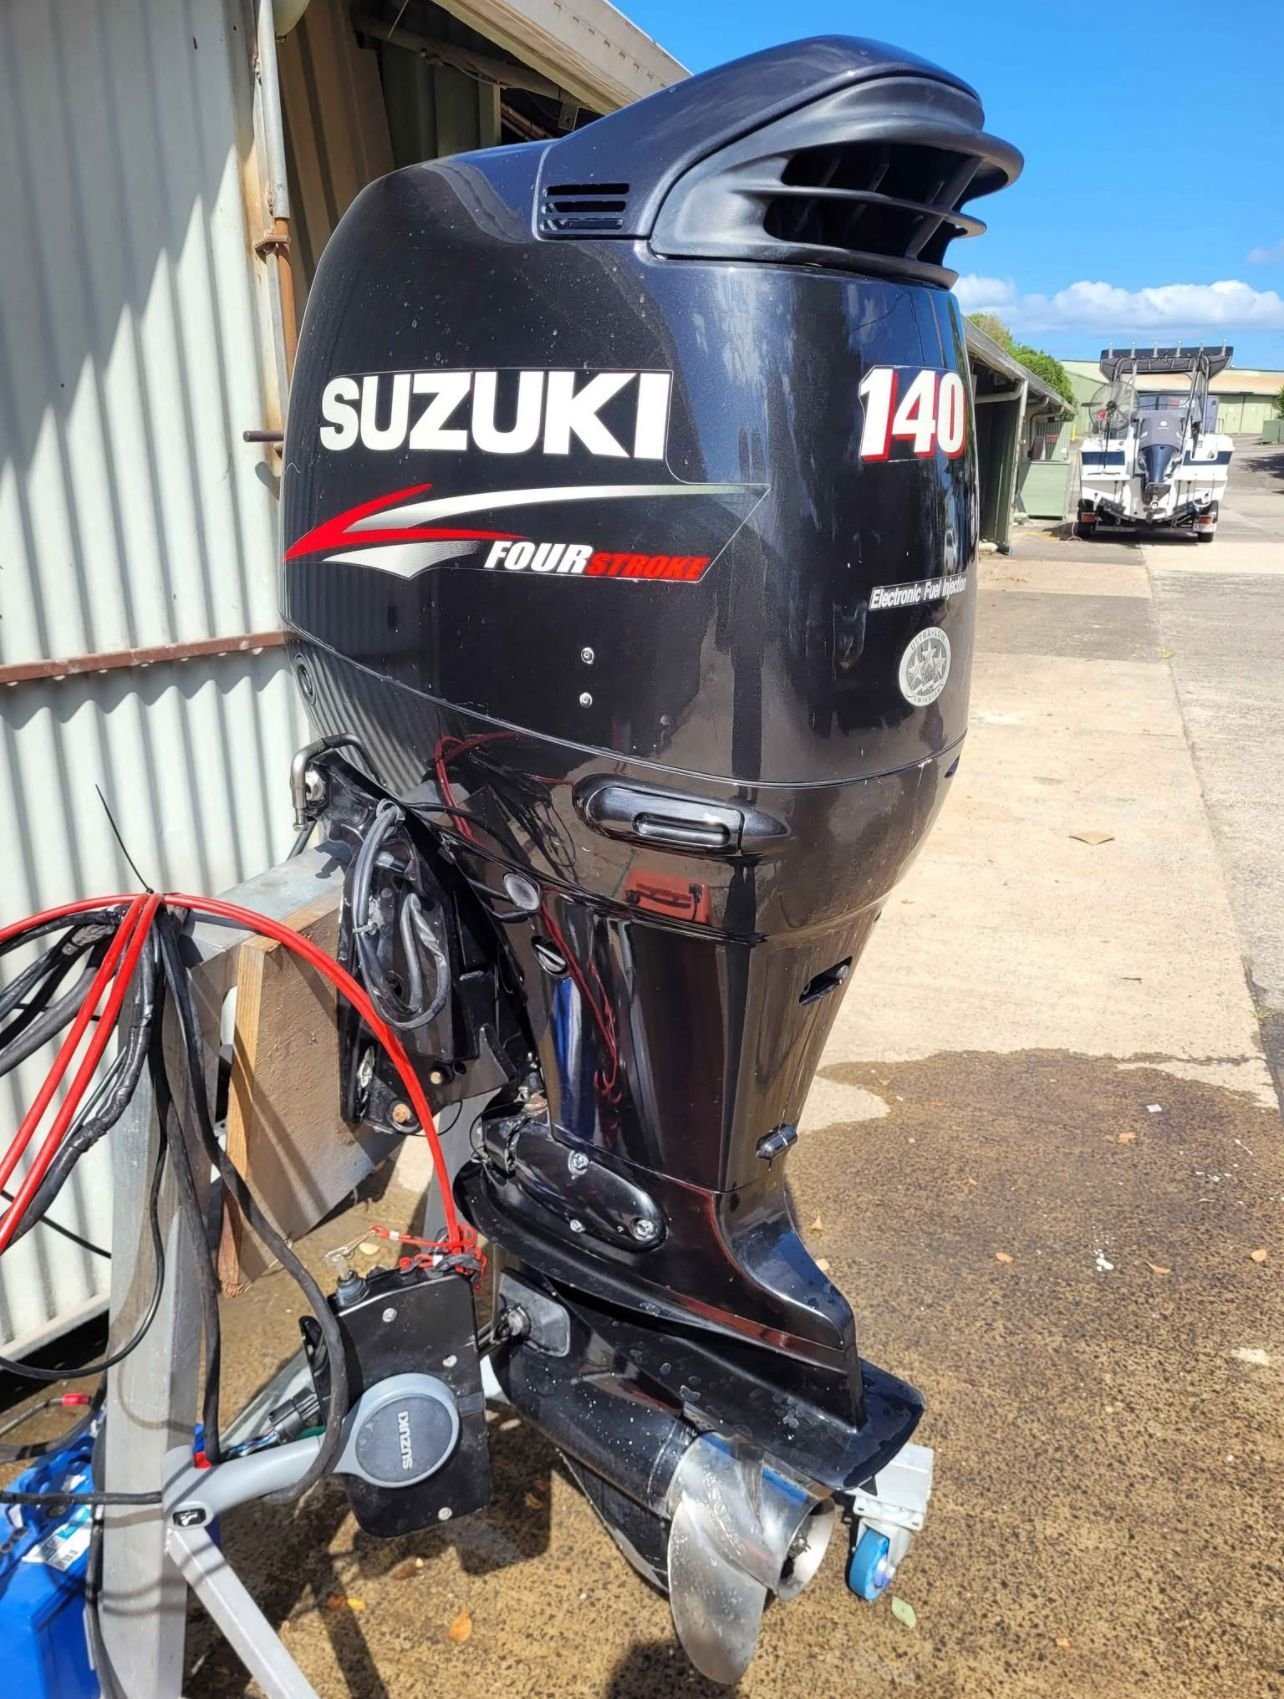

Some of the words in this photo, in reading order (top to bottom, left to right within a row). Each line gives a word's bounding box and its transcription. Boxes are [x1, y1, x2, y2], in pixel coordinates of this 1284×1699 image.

[319, 371, 671, 460] SUZUKI
[860, 368, 966, 461] 140
[483, 540, 594, 575] FOUR
[586, 551, 709, 582] STROKE
[870, 584, 922, 609] Electronic
[923, 580, 941, 601] Fuel
[397, 1411, 412, 1469] SUZUKI
